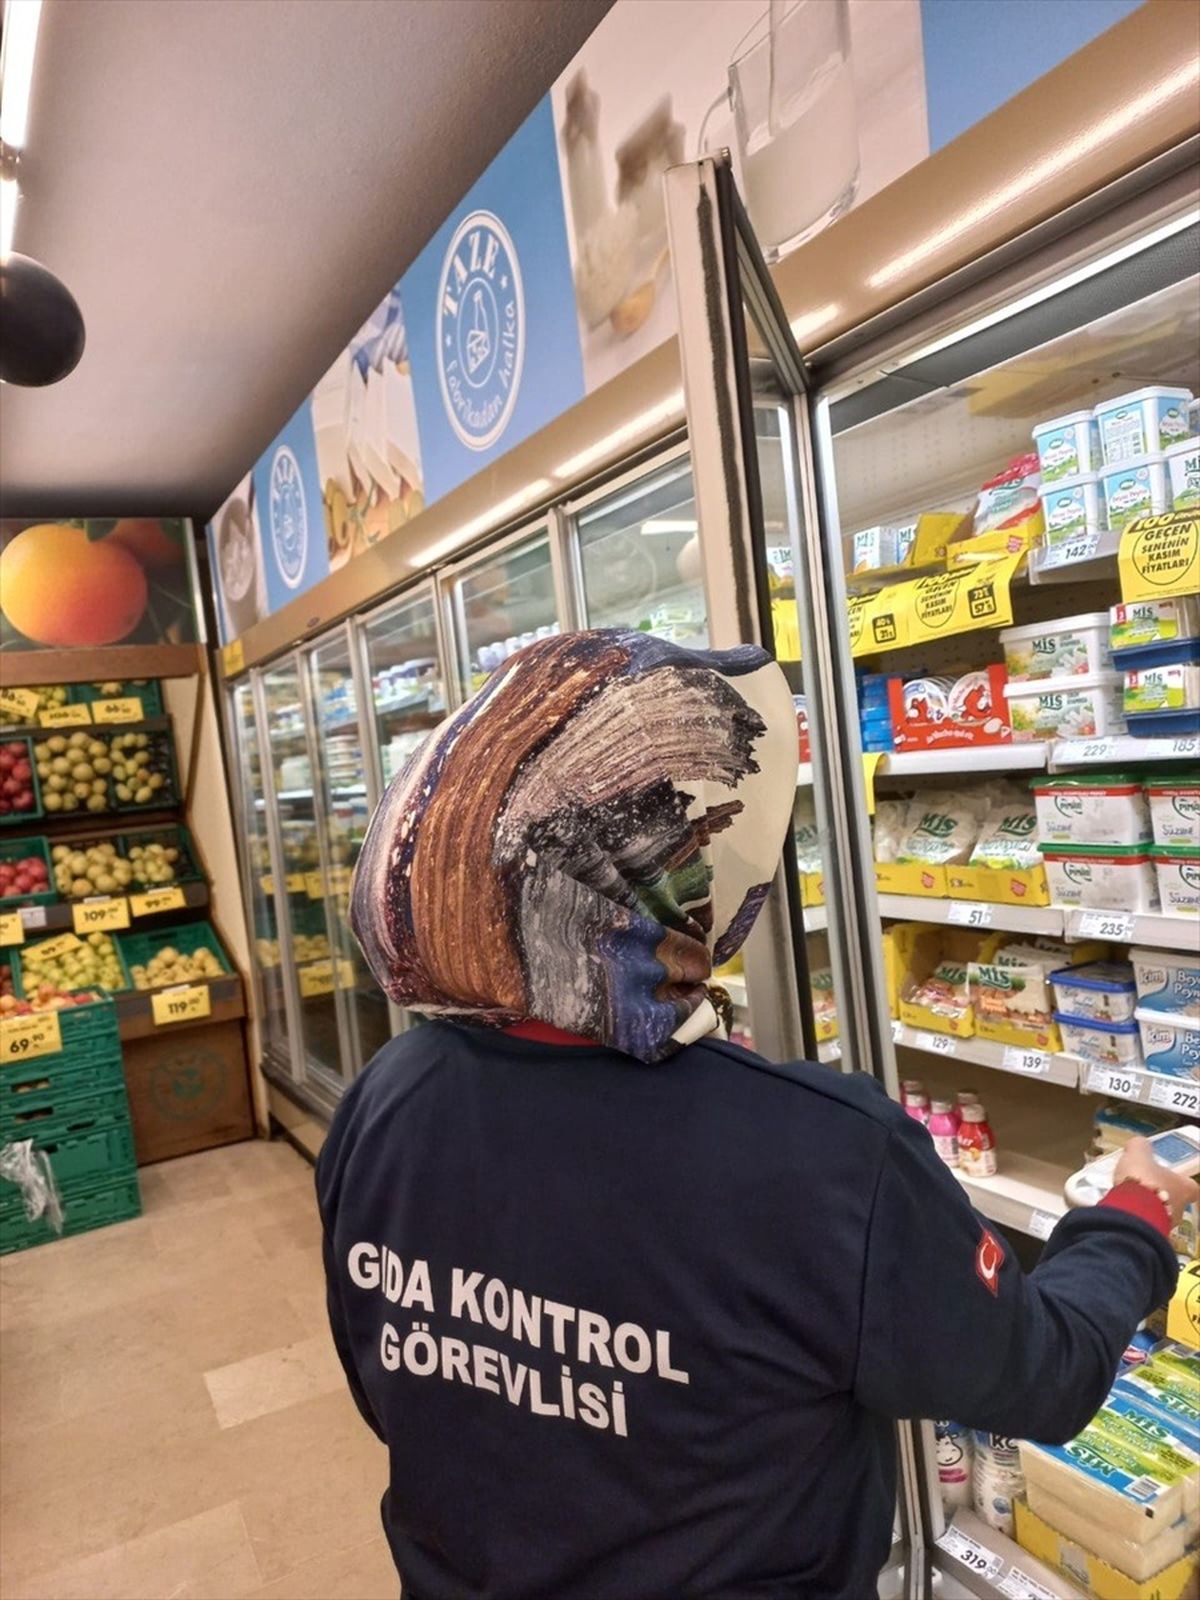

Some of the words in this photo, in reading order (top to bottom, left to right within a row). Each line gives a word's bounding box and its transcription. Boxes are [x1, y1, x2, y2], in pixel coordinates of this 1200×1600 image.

[443, 231, 500, 319] TAZE
[1132, 512, 1176, 532] 100
[1144, 523, 1192, 541] GEÇEN
[1065, 544, 1087, 560] 142
[1141, 537, 1189, 554] SENENİN
[1148, 549, 1181, 562] KASIM
[1142, 558, 1189, 574] FİYATLARI
[1032, 637, 1057, 653] MİS
[1039, 693, 1063, 709] MİS
[1083, 744, 1107, 757] 229
[1173, 740, 1196, 752] 185
[1162, 823, 1193, 836] Süzme
[84, 909, 106, 922] 109
[968, 910, 983, 925] 51
[1100, 922, 1124, 936] 235
[168, 1001, 188, 1015] 119
[10, 1038, 29, 1054] 69
[32, 1033, 45, 1042] 90
[932, 1036, 949, 1050] 129
[1023, 1056, 1042, 1069] 139
[1108, 1077, 1131, 1093] 130
[1172, 1092, 1198, 1110] 272
[347, 1242, 435, 1312] GIDA
[451, 1268, 690, 1384] KONTROL
[380, 1321, 628, 1437] GÖREVLİSİ
[960, 1549, 987, 1569] 319
